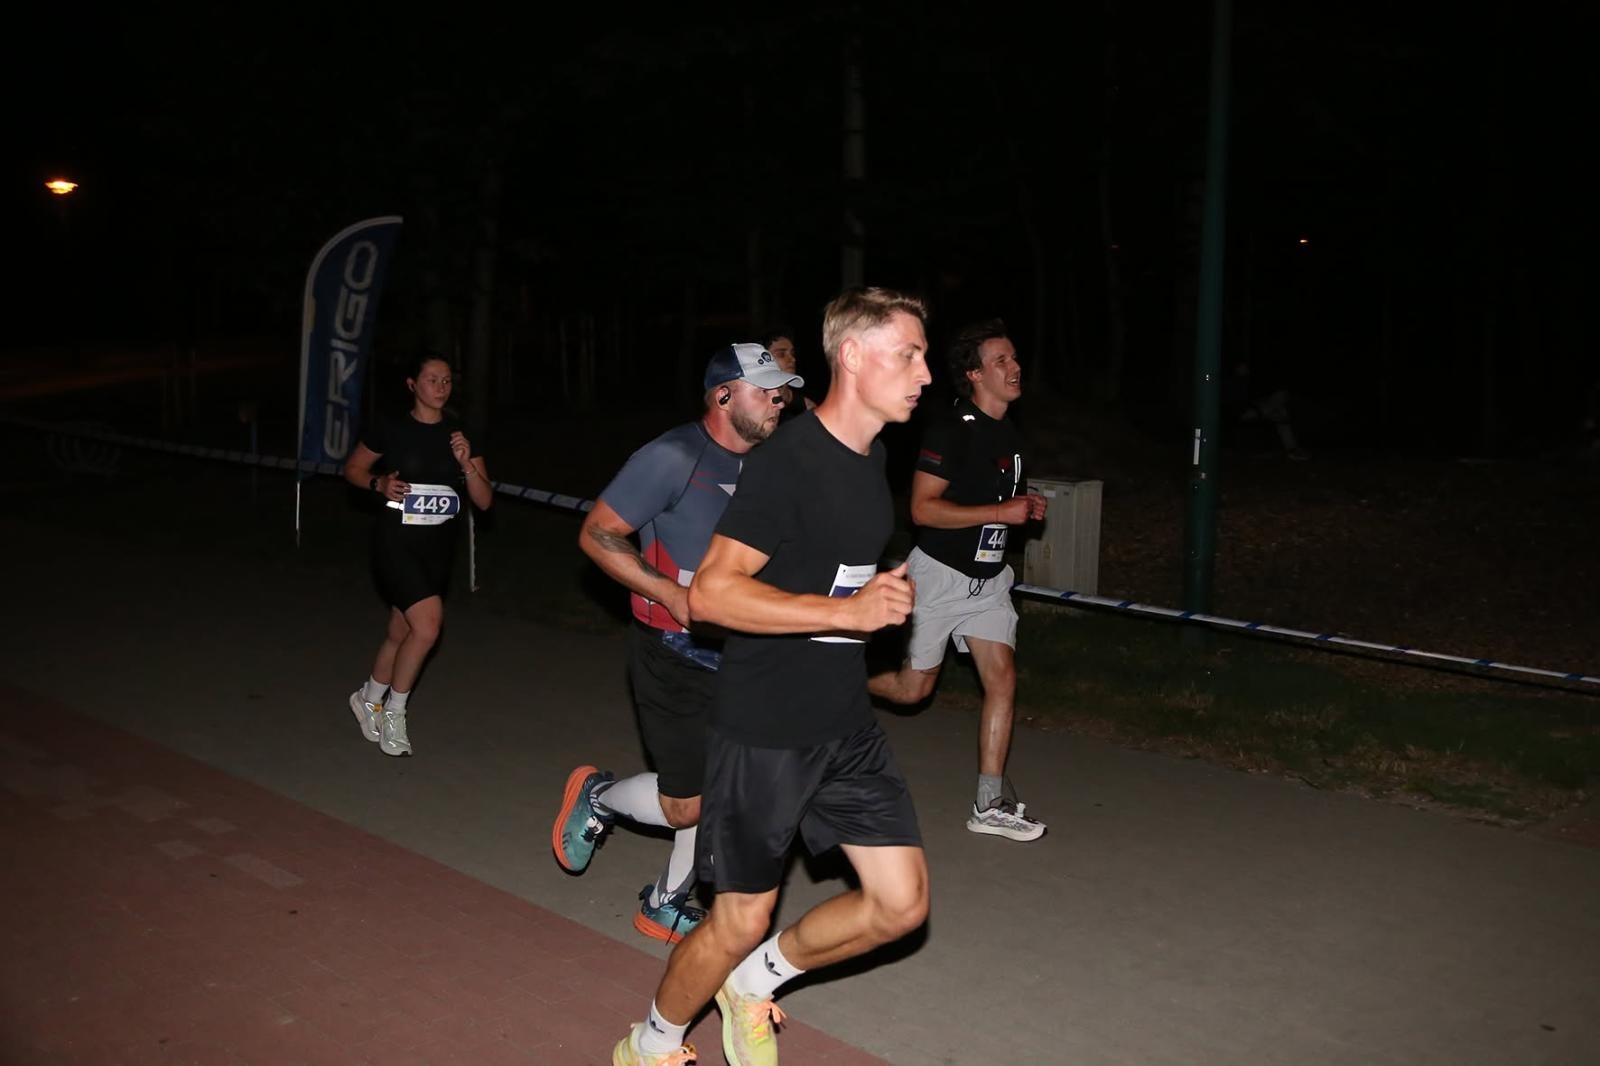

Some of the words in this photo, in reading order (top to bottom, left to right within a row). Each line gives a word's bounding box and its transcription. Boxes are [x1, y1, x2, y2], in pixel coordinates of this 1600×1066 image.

[324, 240, 378, 460] ERIGO
[412, 496, 451, 514] 449
[988, 530, 1008, 549] 44
